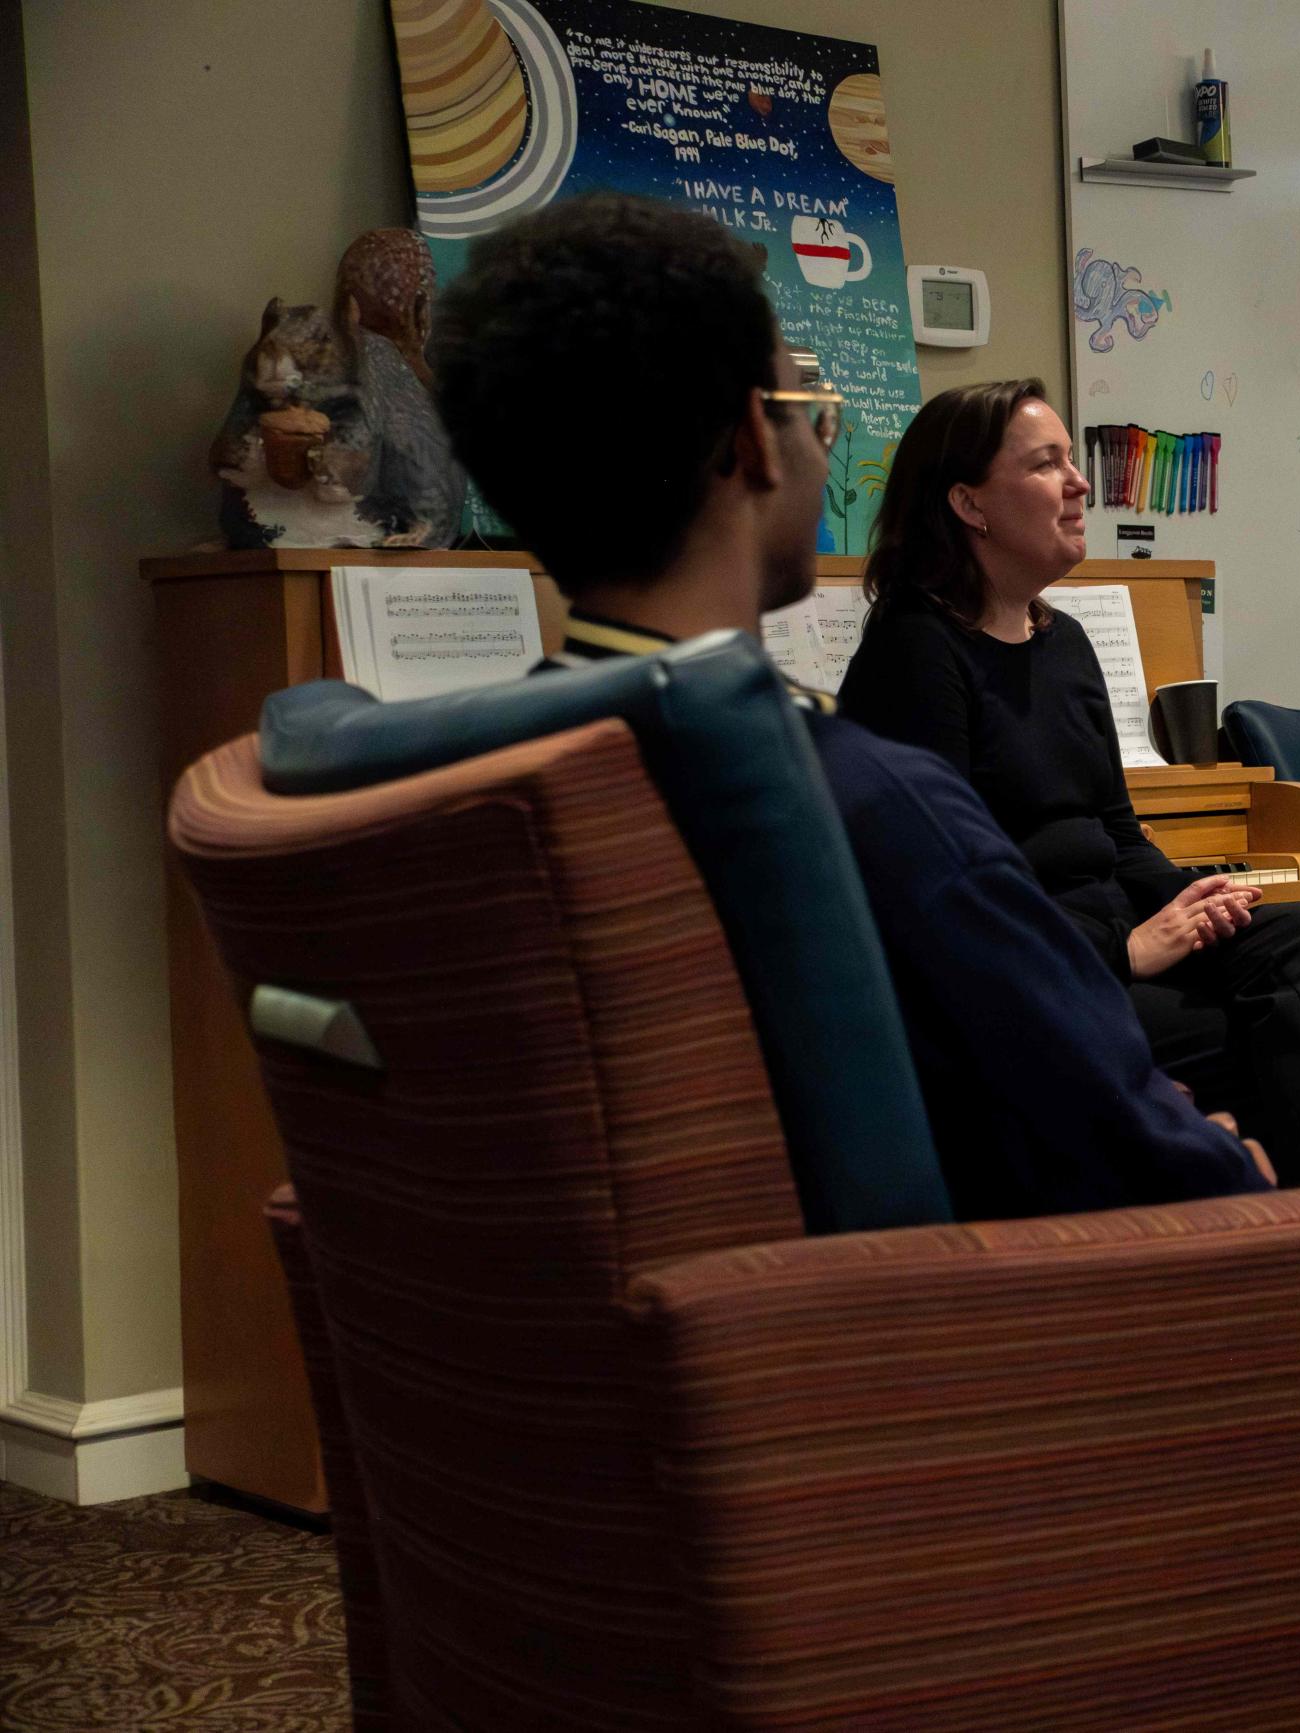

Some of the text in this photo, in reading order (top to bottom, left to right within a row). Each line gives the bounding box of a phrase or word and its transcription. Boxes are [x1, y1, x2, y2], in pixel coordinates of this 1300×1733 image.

[566, 41, 596, 57] deal
[600, 50, 636, 64] more
[680, 61, 709, 75] with
[712, 66, 734, 78] one
[788, 79, 812, 91] and
[813, 84, 827, 96] to
[725, 57, 804, 80] responsibility
[810, 69, 824, 82] to
[629, 65, 653, 76] and
[655, 67, 700, 83] cherish
[750, 81, 775, 96] blue
[801, 91, 822, 105] the
[638, 78, 698, 106] HOME
[626, 98, 666, 114] ever
[705, 128, 733, 148] Pale
[734, 132, 767, 152] Blue
[674, 147, 701, 164] 1994
[693, 179, 745, 204] HAVE
[750, 186, 766, 206] A
[855, 364, 888, 382] world
